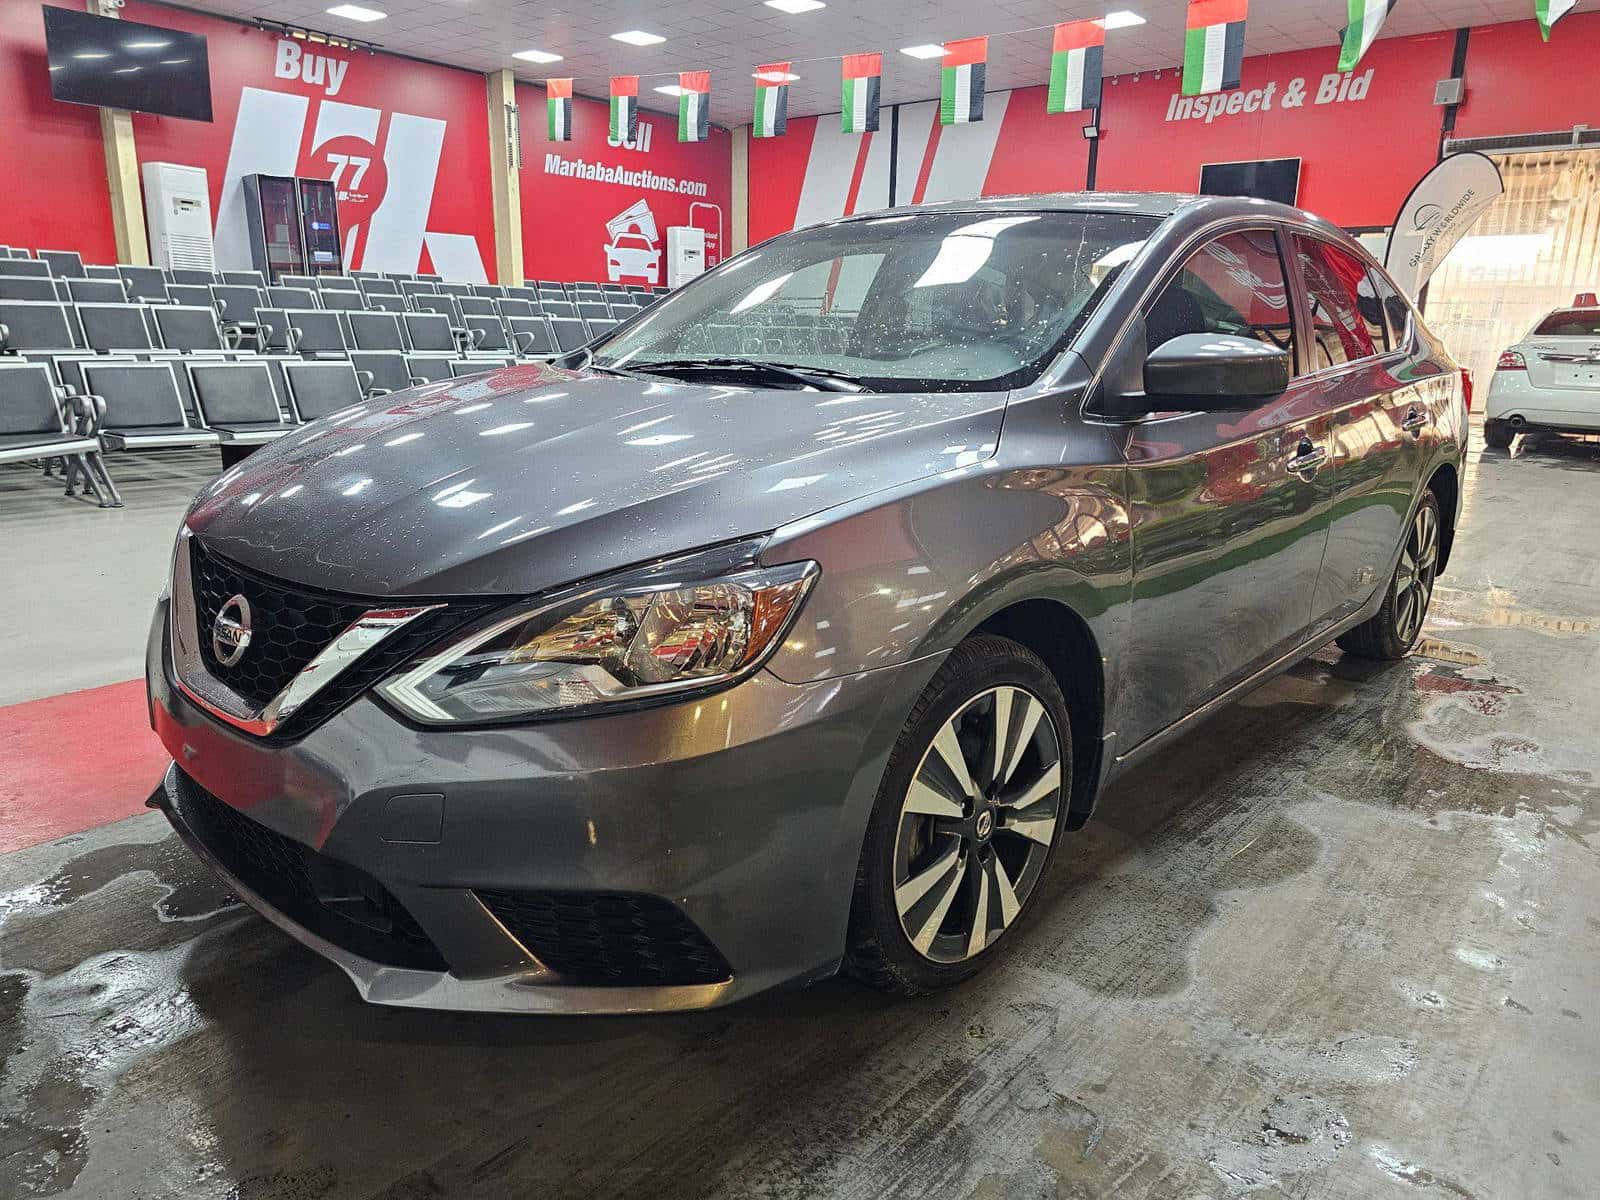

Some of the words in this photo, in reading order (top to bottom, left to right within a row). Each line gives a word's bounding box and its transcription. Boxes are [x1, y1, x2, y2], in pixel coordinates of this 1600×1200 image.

[275, 40, 349, 96] Buy
[1165, 82, 1275, 123] Inspect
[1281, 78, 1306, 108] &
[1314, 69, 1375, 104] Bid
[608, 119, 653, 153] ll
[327, 153, 371, 191] 77
[544, 154, 707, 196] MarhabaAuctions.com
